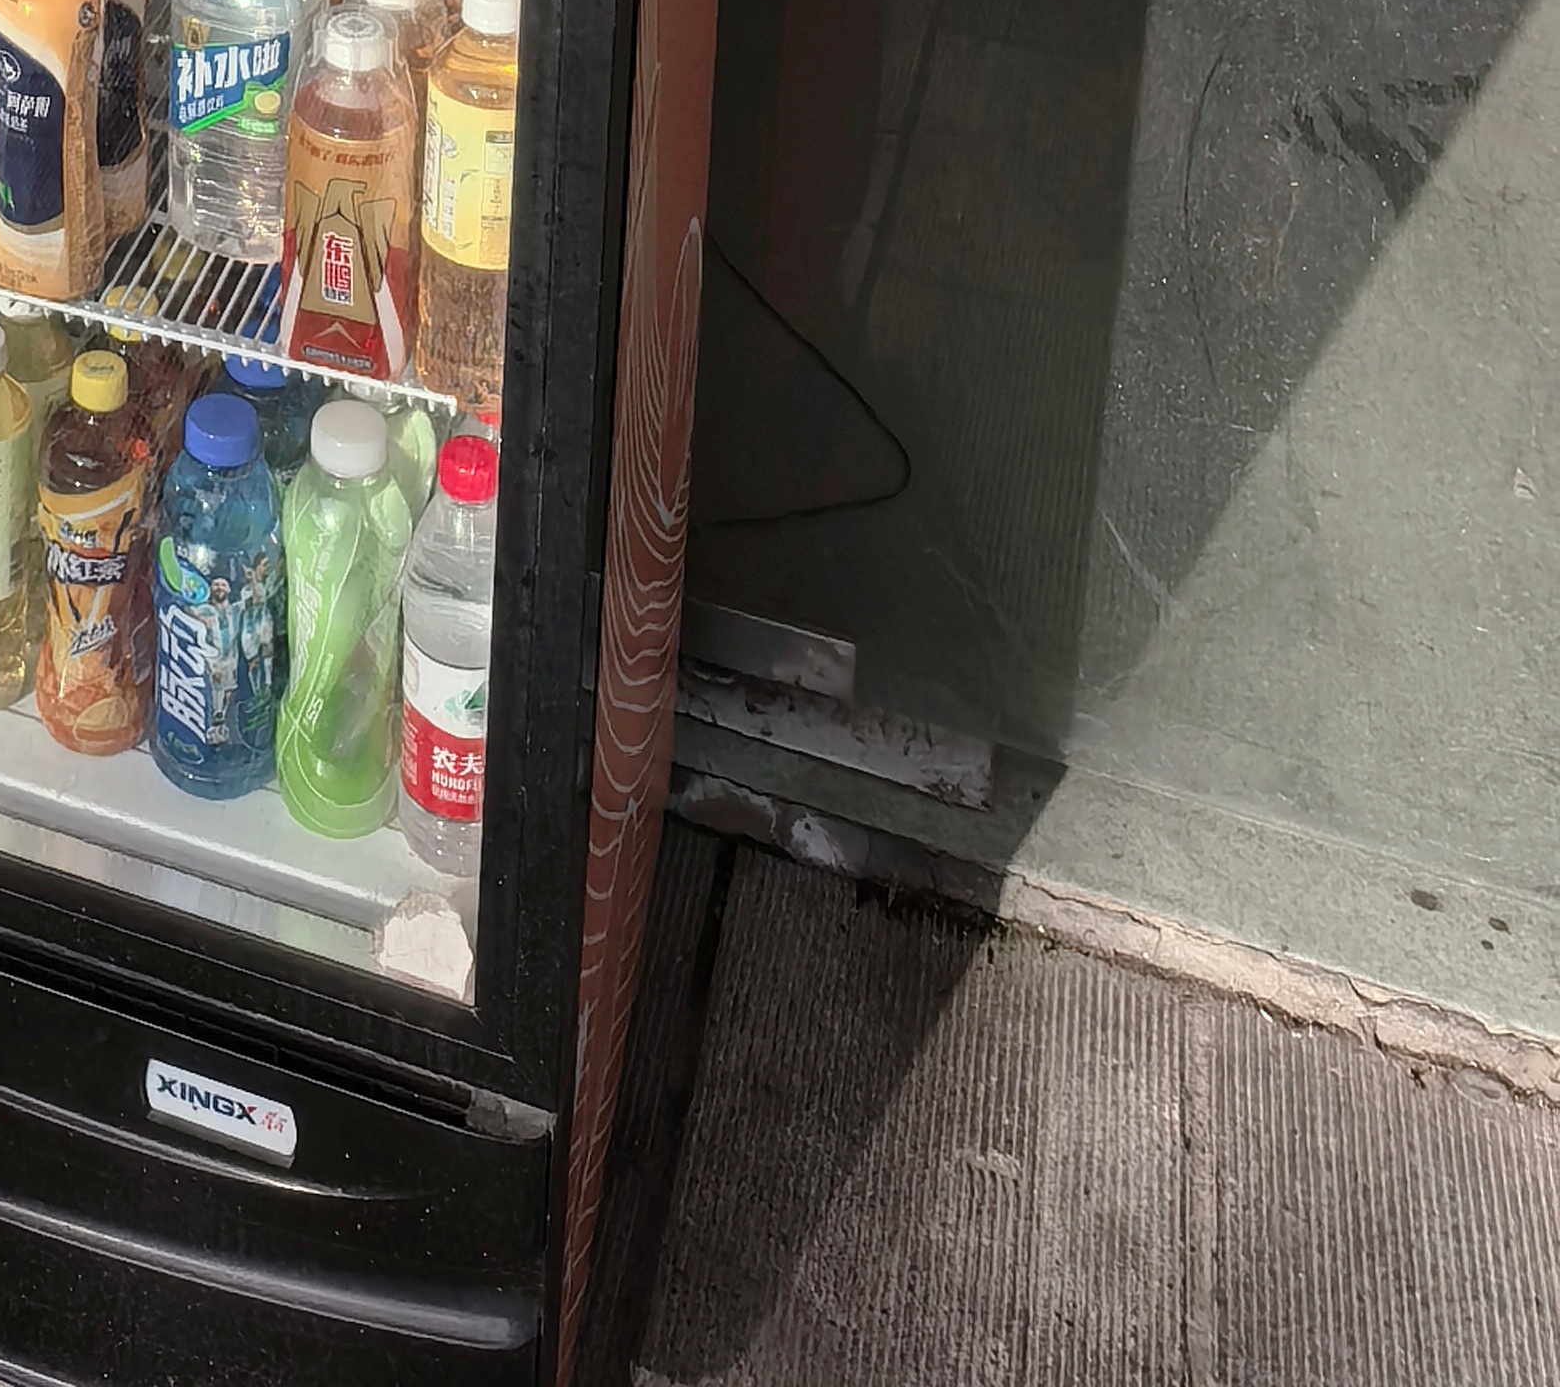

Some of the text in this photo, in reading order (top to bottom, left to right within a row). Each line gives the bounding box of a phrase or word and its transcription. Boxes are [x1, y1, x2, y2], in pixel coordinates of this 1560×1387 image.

[177, 38, 281, 104] 补水啦
[324, 232, 354, 291] 东鹏
[156, 1073, 258, 1125] XINGX
